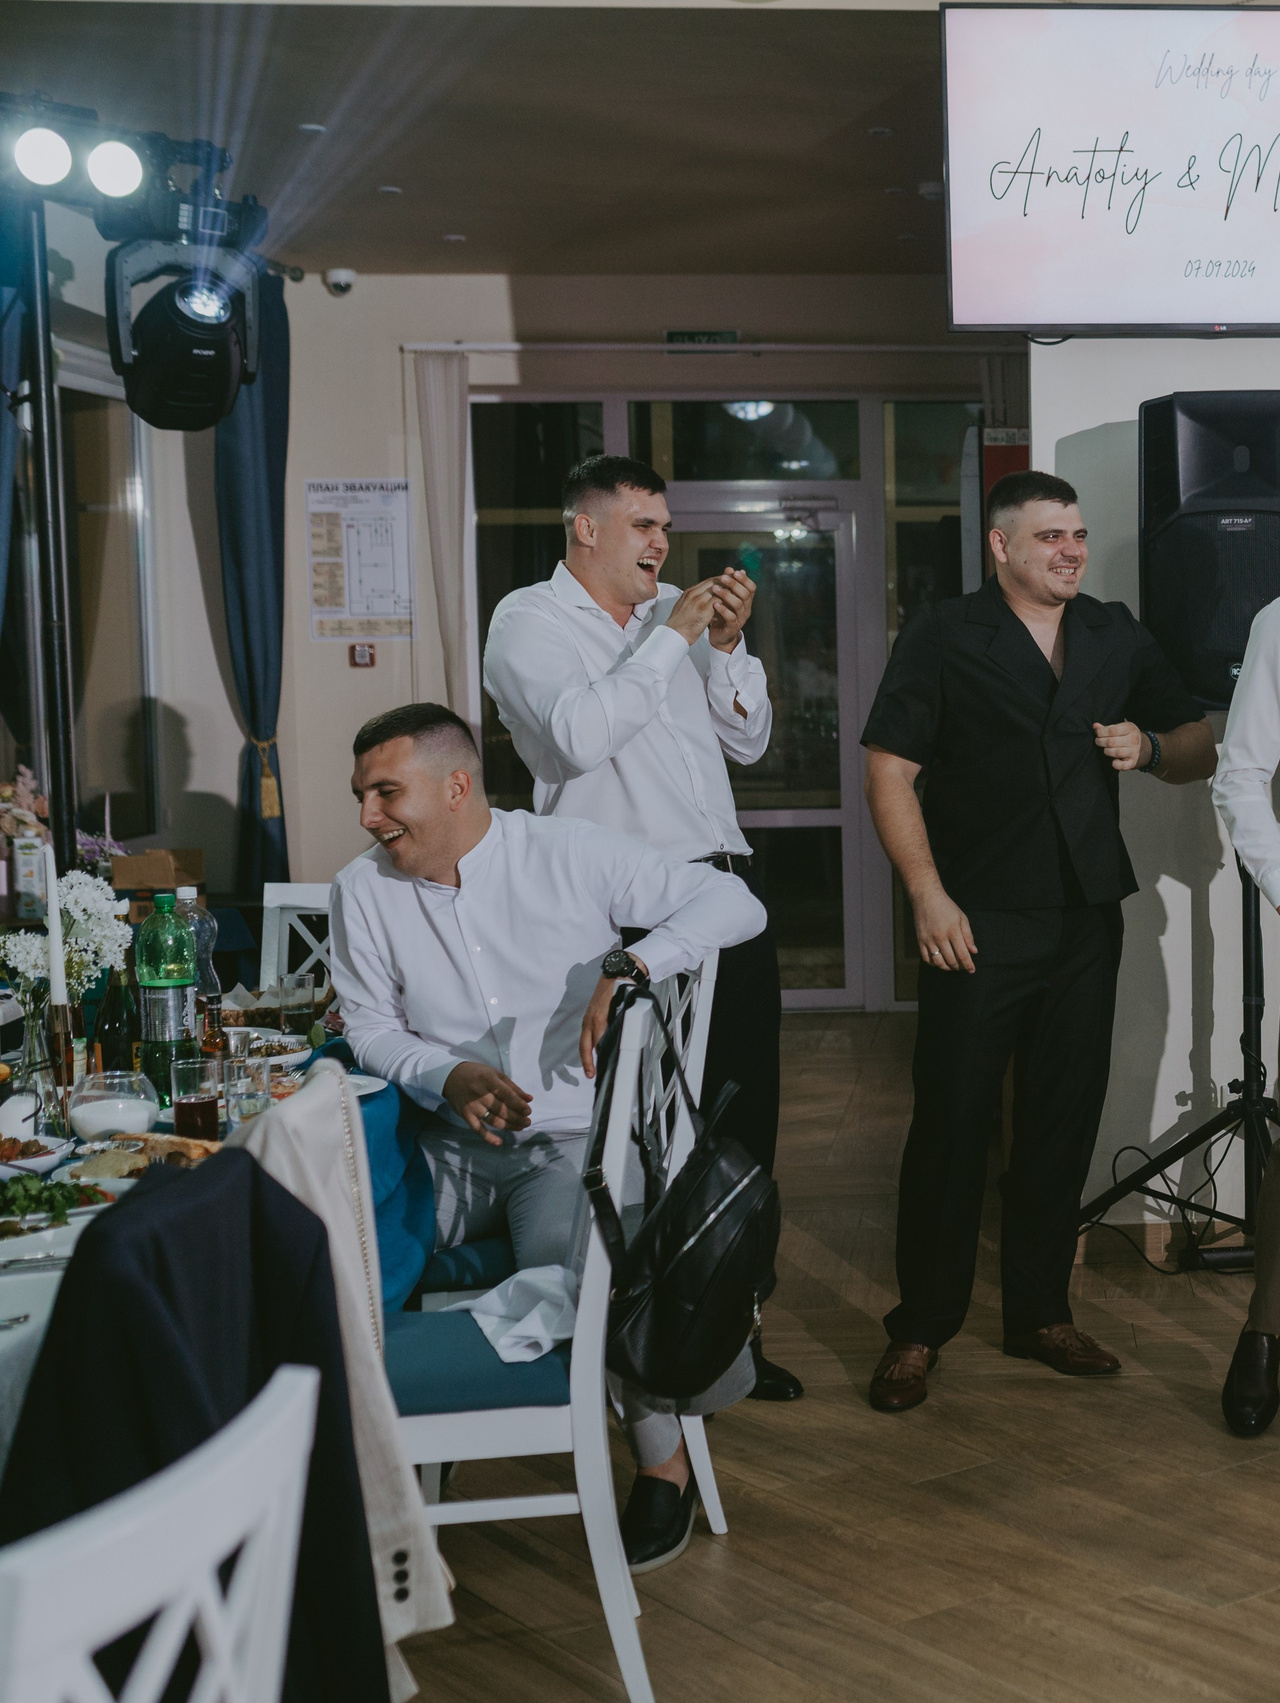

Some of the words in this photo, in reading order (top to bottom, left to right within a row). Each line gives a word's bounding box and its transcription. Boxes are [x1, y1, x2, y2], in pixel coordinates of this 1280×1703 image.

[1155, 49, 1240, 99] Wedding
[1245, 52, 1278, 101] day
[1177, 155, 1200, 190] &
[1184, 259, 1256, 278] 07.09.2024
[308, 482, 339, 493] ПЛАН
[342, 482, 409, 494] ЭВАКУАЦИИ
